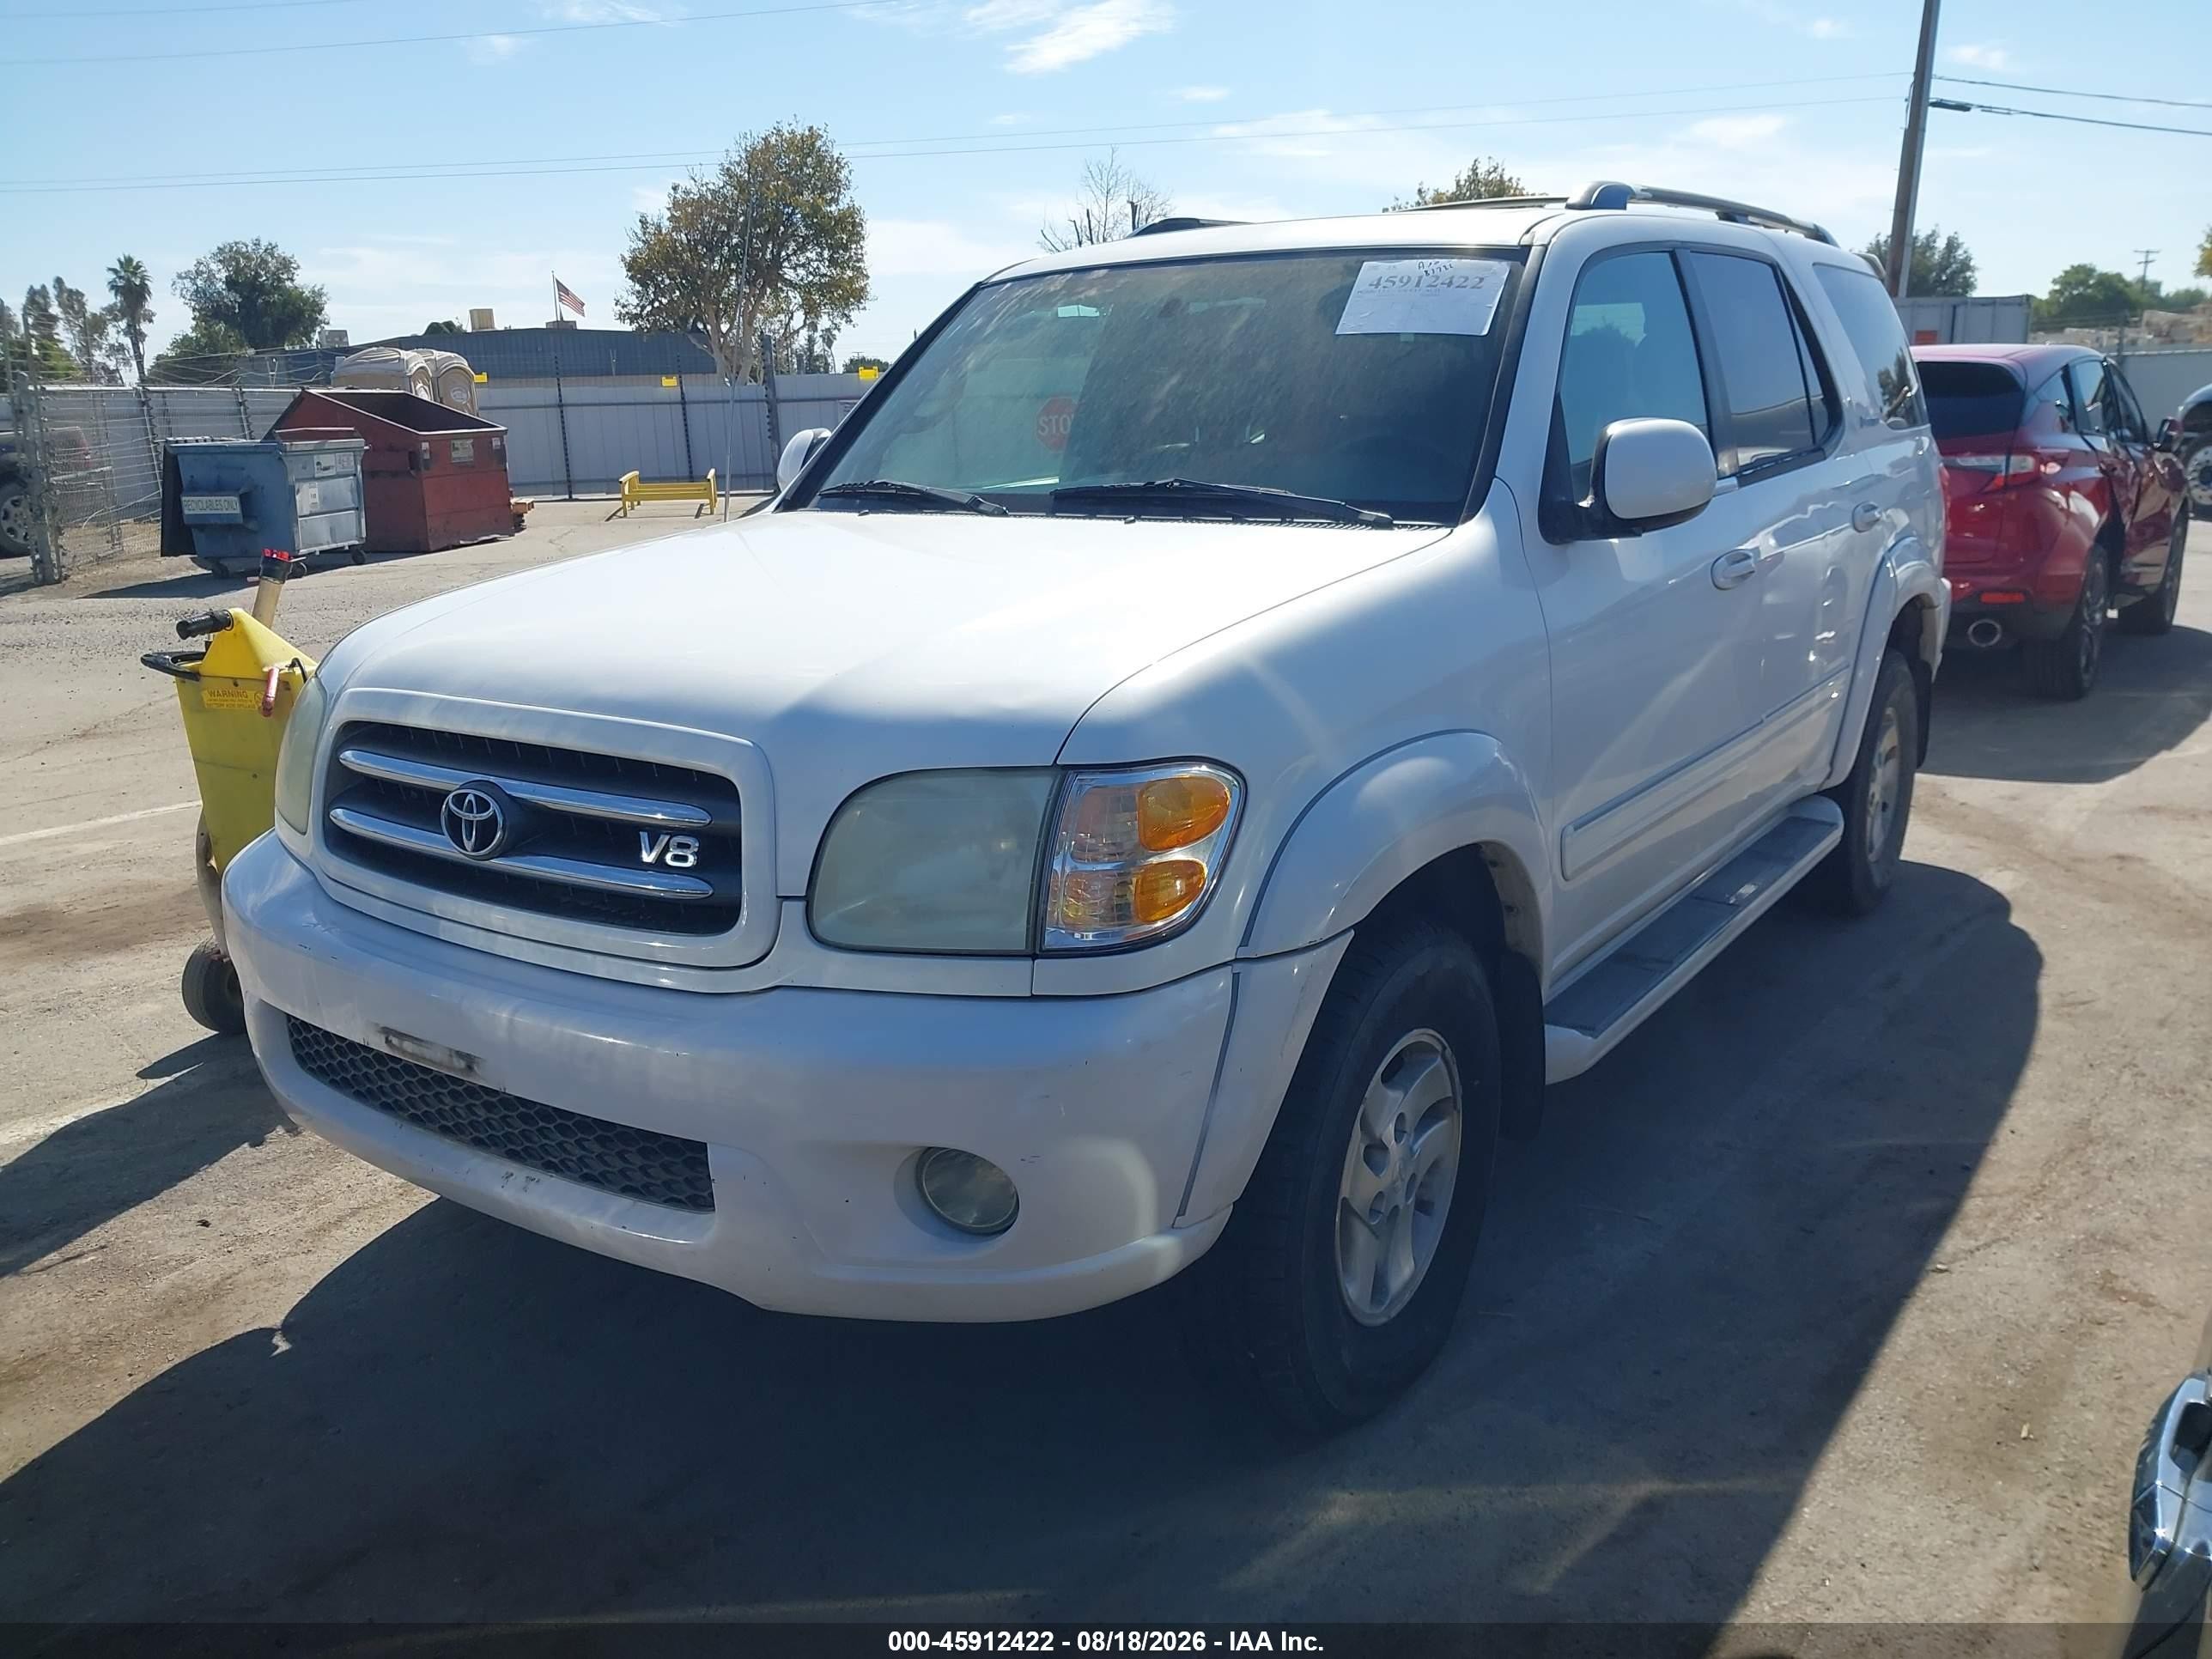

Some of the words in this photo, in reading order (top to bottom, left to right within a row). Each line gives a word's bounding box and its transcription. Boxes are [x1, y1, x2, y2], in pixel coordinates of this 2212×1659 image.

[1368, 274, 1485, 289] 45912422
[1038, 414, 1072, 435] STO
[183, 499, 223, 512] RECYCLABLES
[224, 499, 238, 511] ONLY
[208, 690, 248, 698] WARNING
[640, 831, 699, 867] V8
